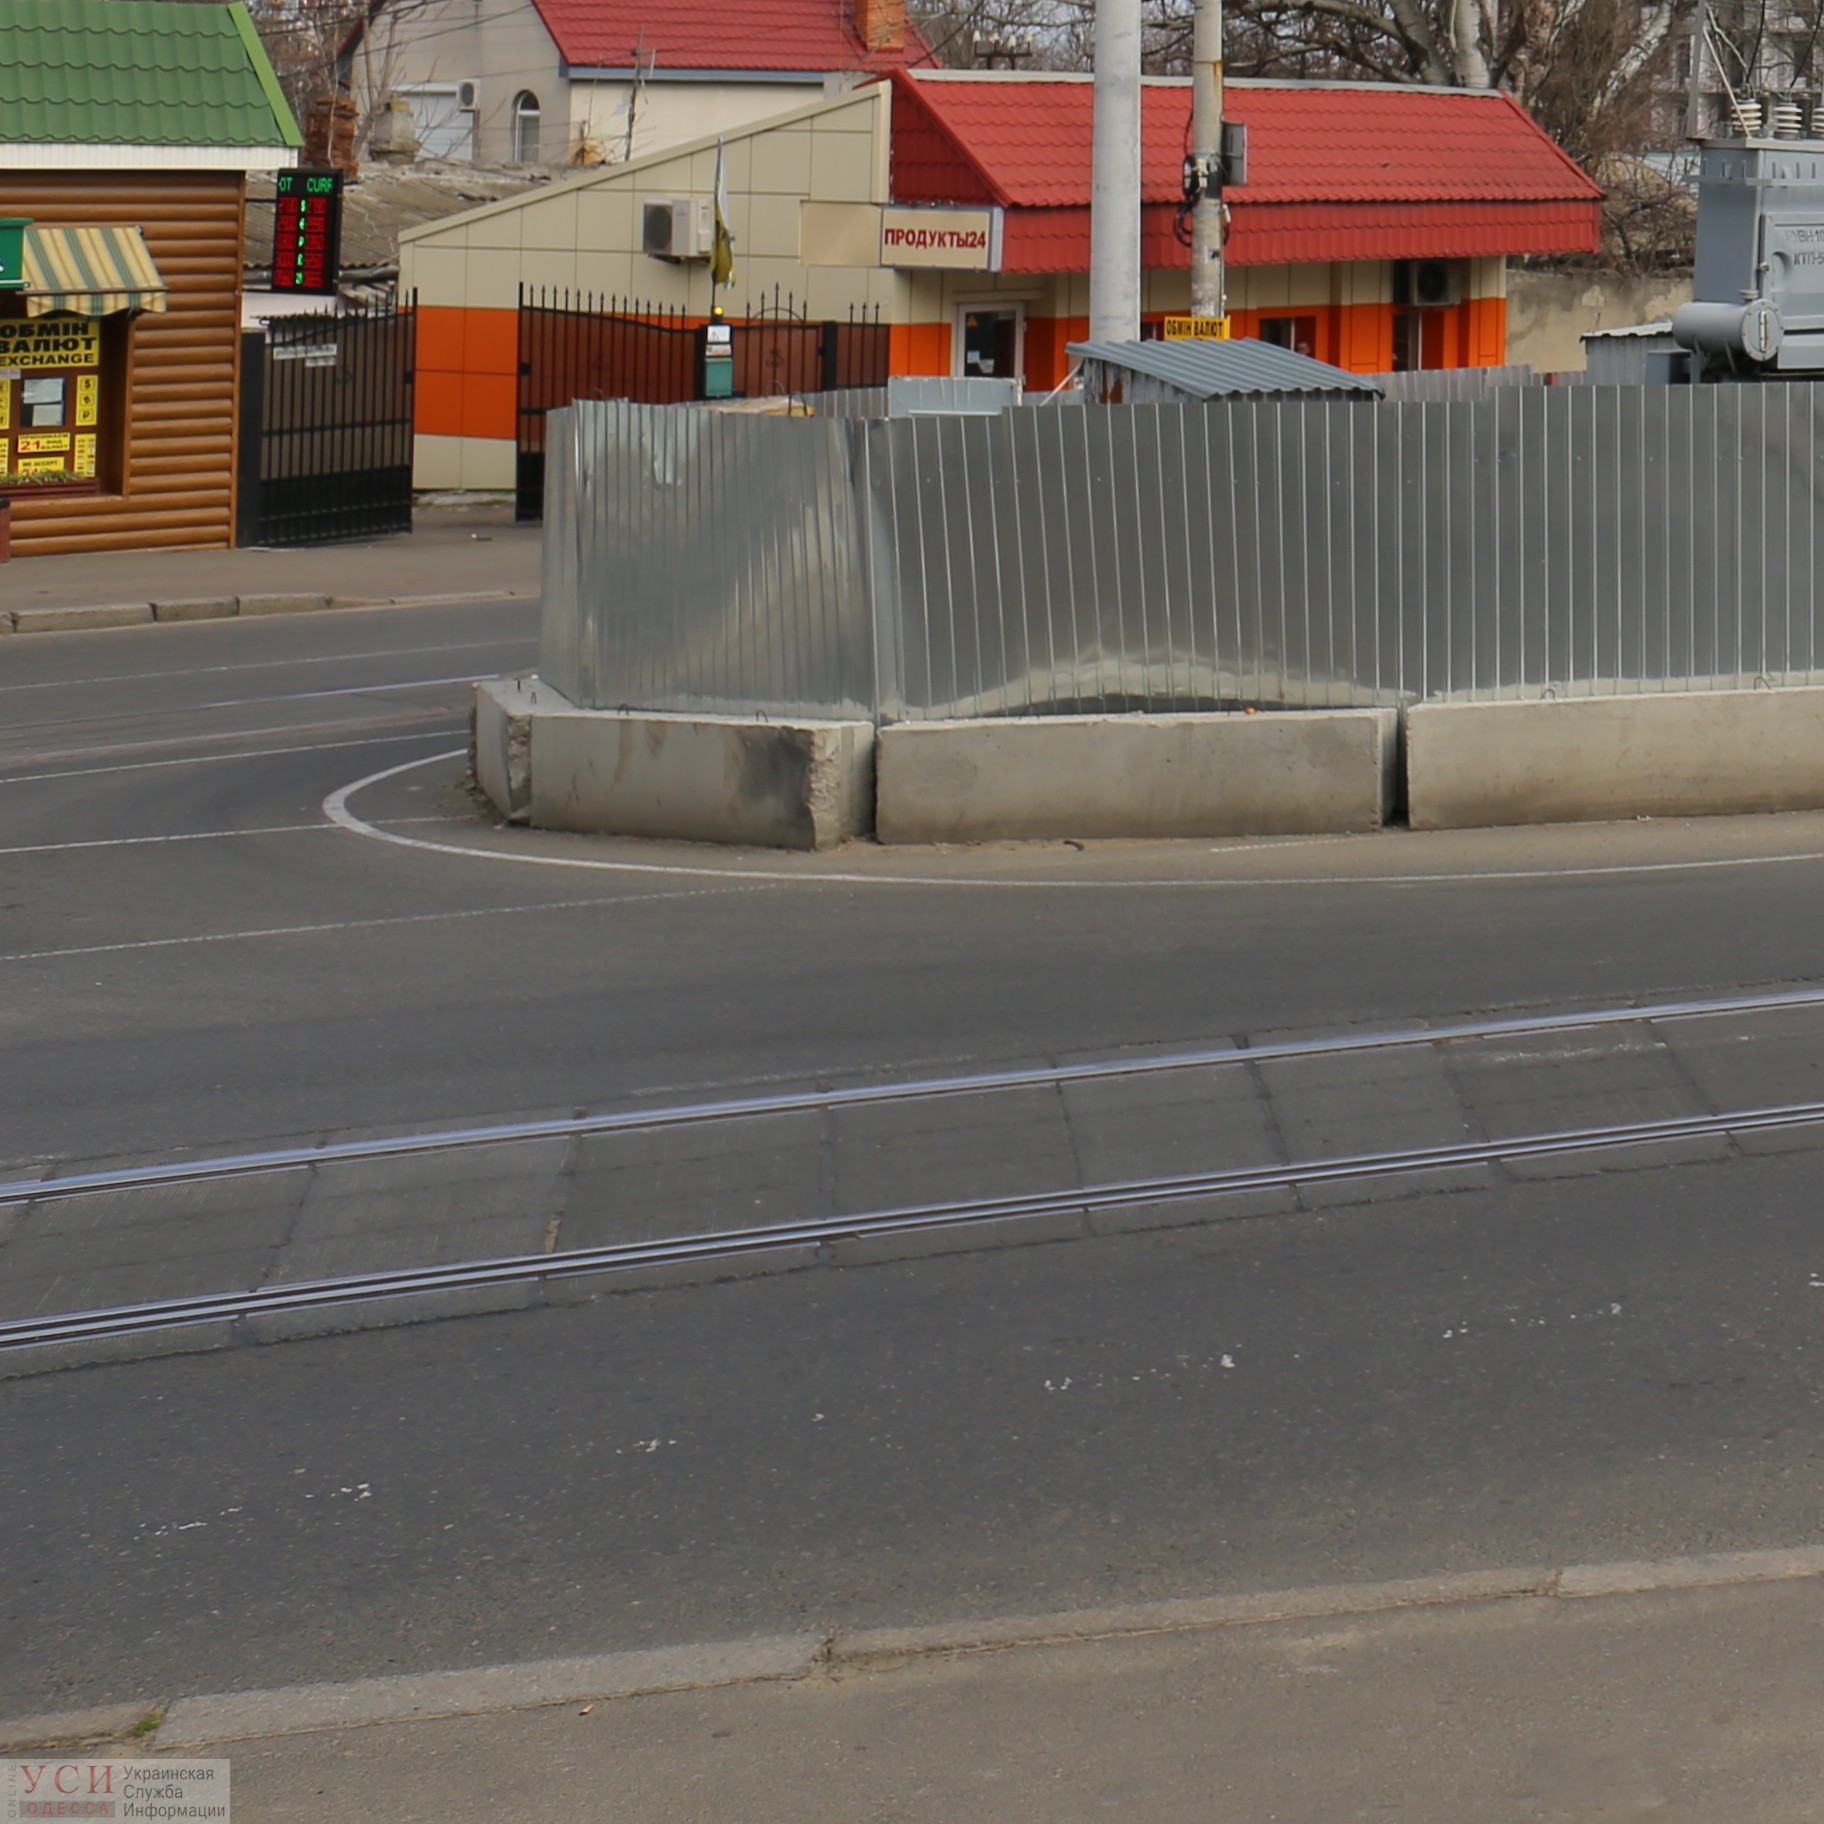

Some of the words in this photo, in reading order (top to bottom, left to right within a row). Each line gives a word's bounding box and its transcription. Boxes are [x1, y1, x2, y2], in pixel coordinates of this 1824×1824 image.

[884, 227, 986, 249] ПРОДУКТЫ24
[0, 322, 89, 338] ОБМІН
[1166, 319, 1192, 336] ОБМІН
[1193, 320, 1223, 337] ВАЛЮТ
[0, 337, 97, 353] ВАЛЮТ
[0, 353, 95, 366] EXCHANGE
